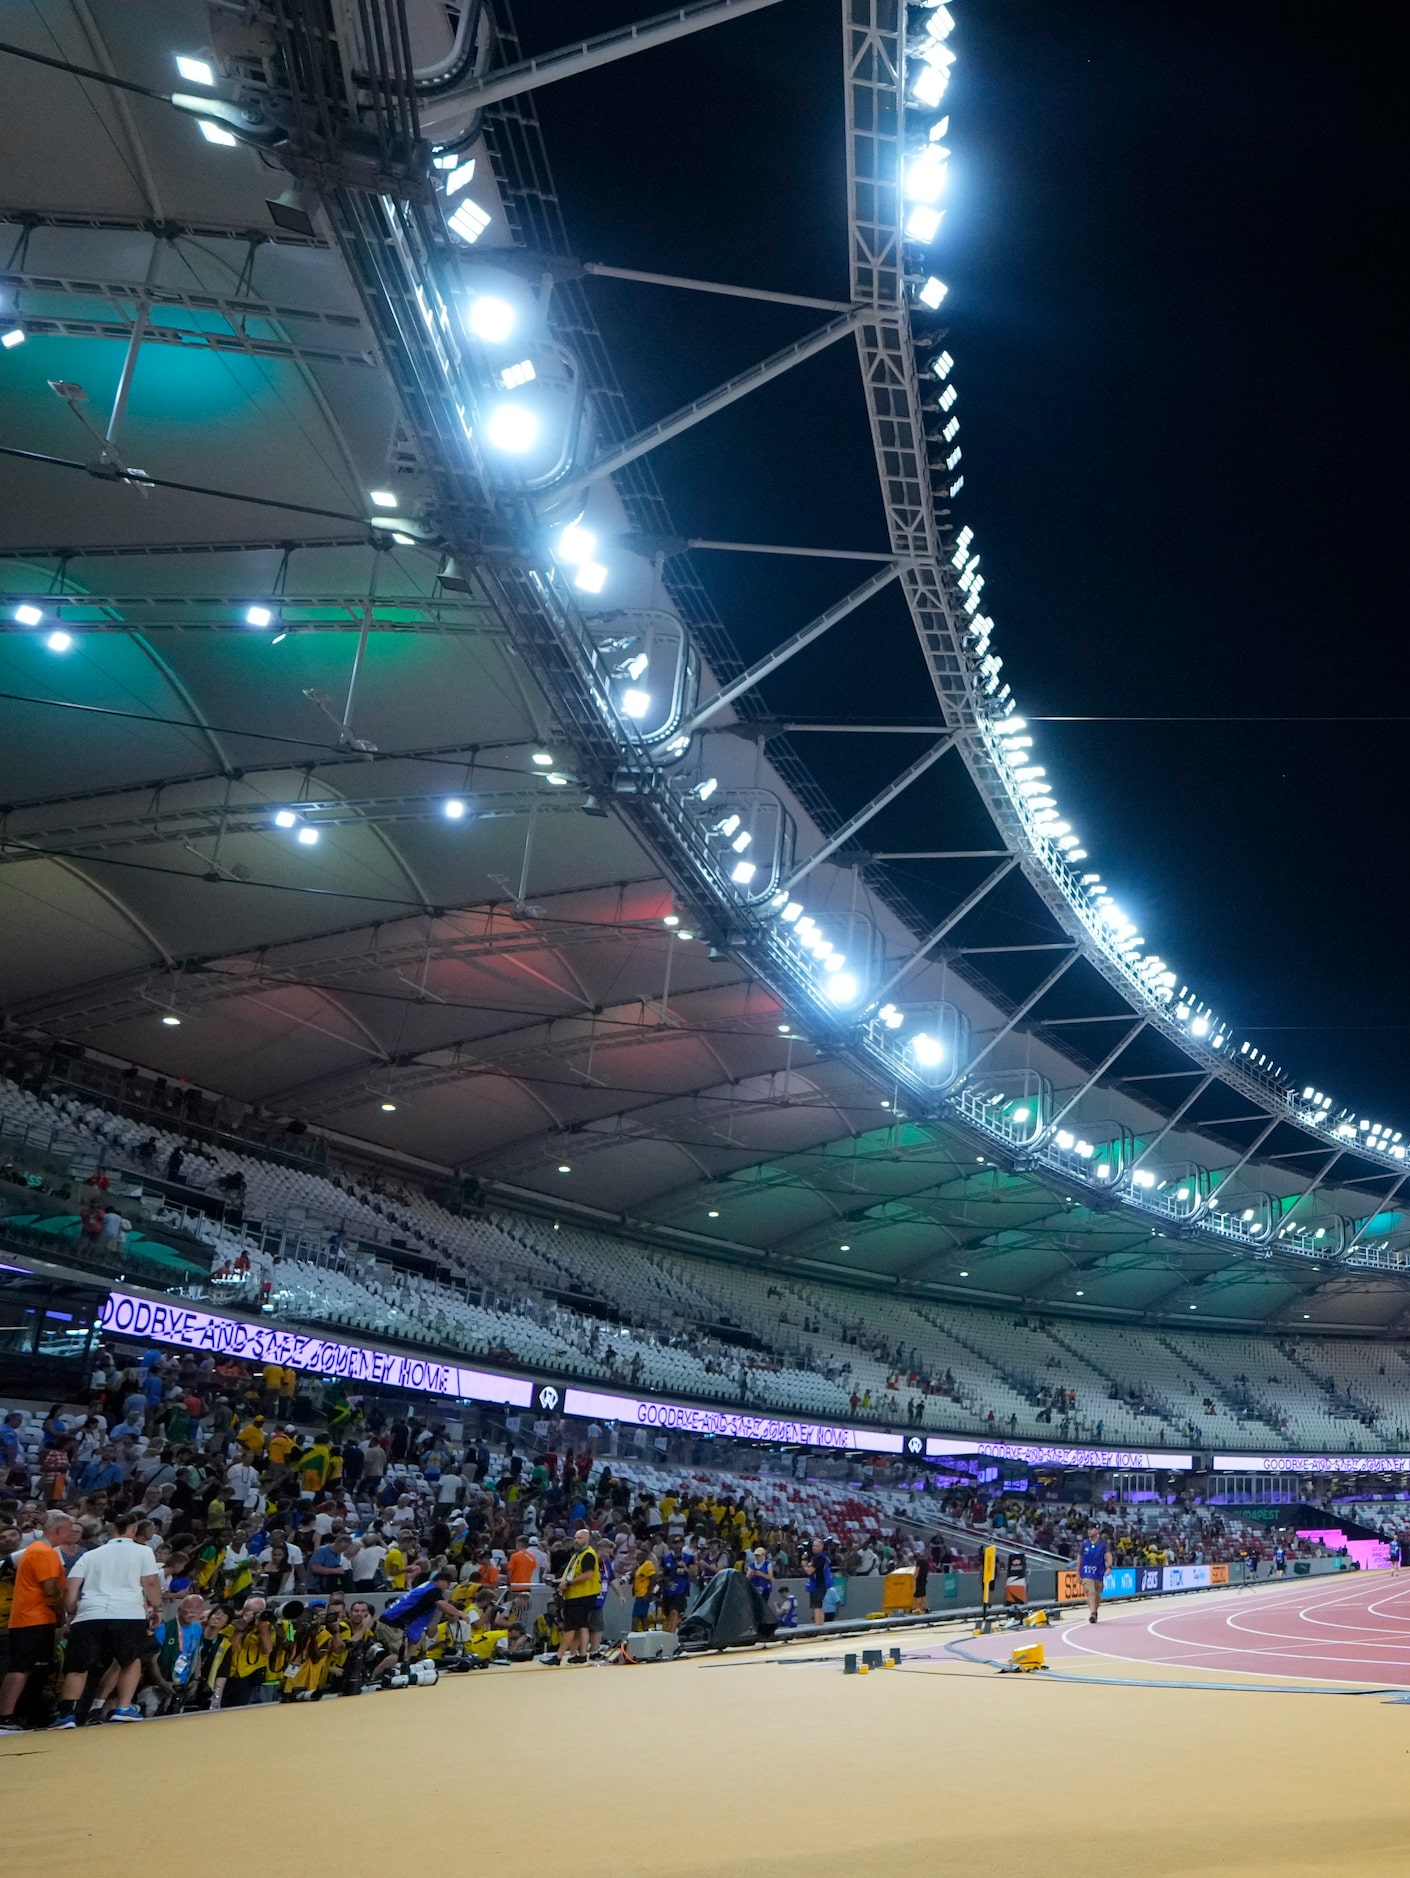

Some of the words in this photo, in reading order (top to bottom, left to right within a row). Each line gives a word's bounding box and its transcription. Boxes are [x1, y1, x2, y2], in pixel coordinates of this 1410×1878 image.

[200, 1319, 248, 1353] AND
[252, 1330, 306, 1365] SAFE
[309, 1342, 396, 1384] JOURNEY
[401, 1358, 450, 1392] HOME
[637, 1402, 700, 1431] GOODBYE
[702, 1413, 728, 1433] AND
[817, 1426, 848, 1447] HOME
[1115, 1453, 1144, 1467] HOME
[1234, 1509, 1281, 1520] UDAPEST
[1083, 1564, 1098, 1574] 119
[1121, 1573, 1133, 1590] NTN
